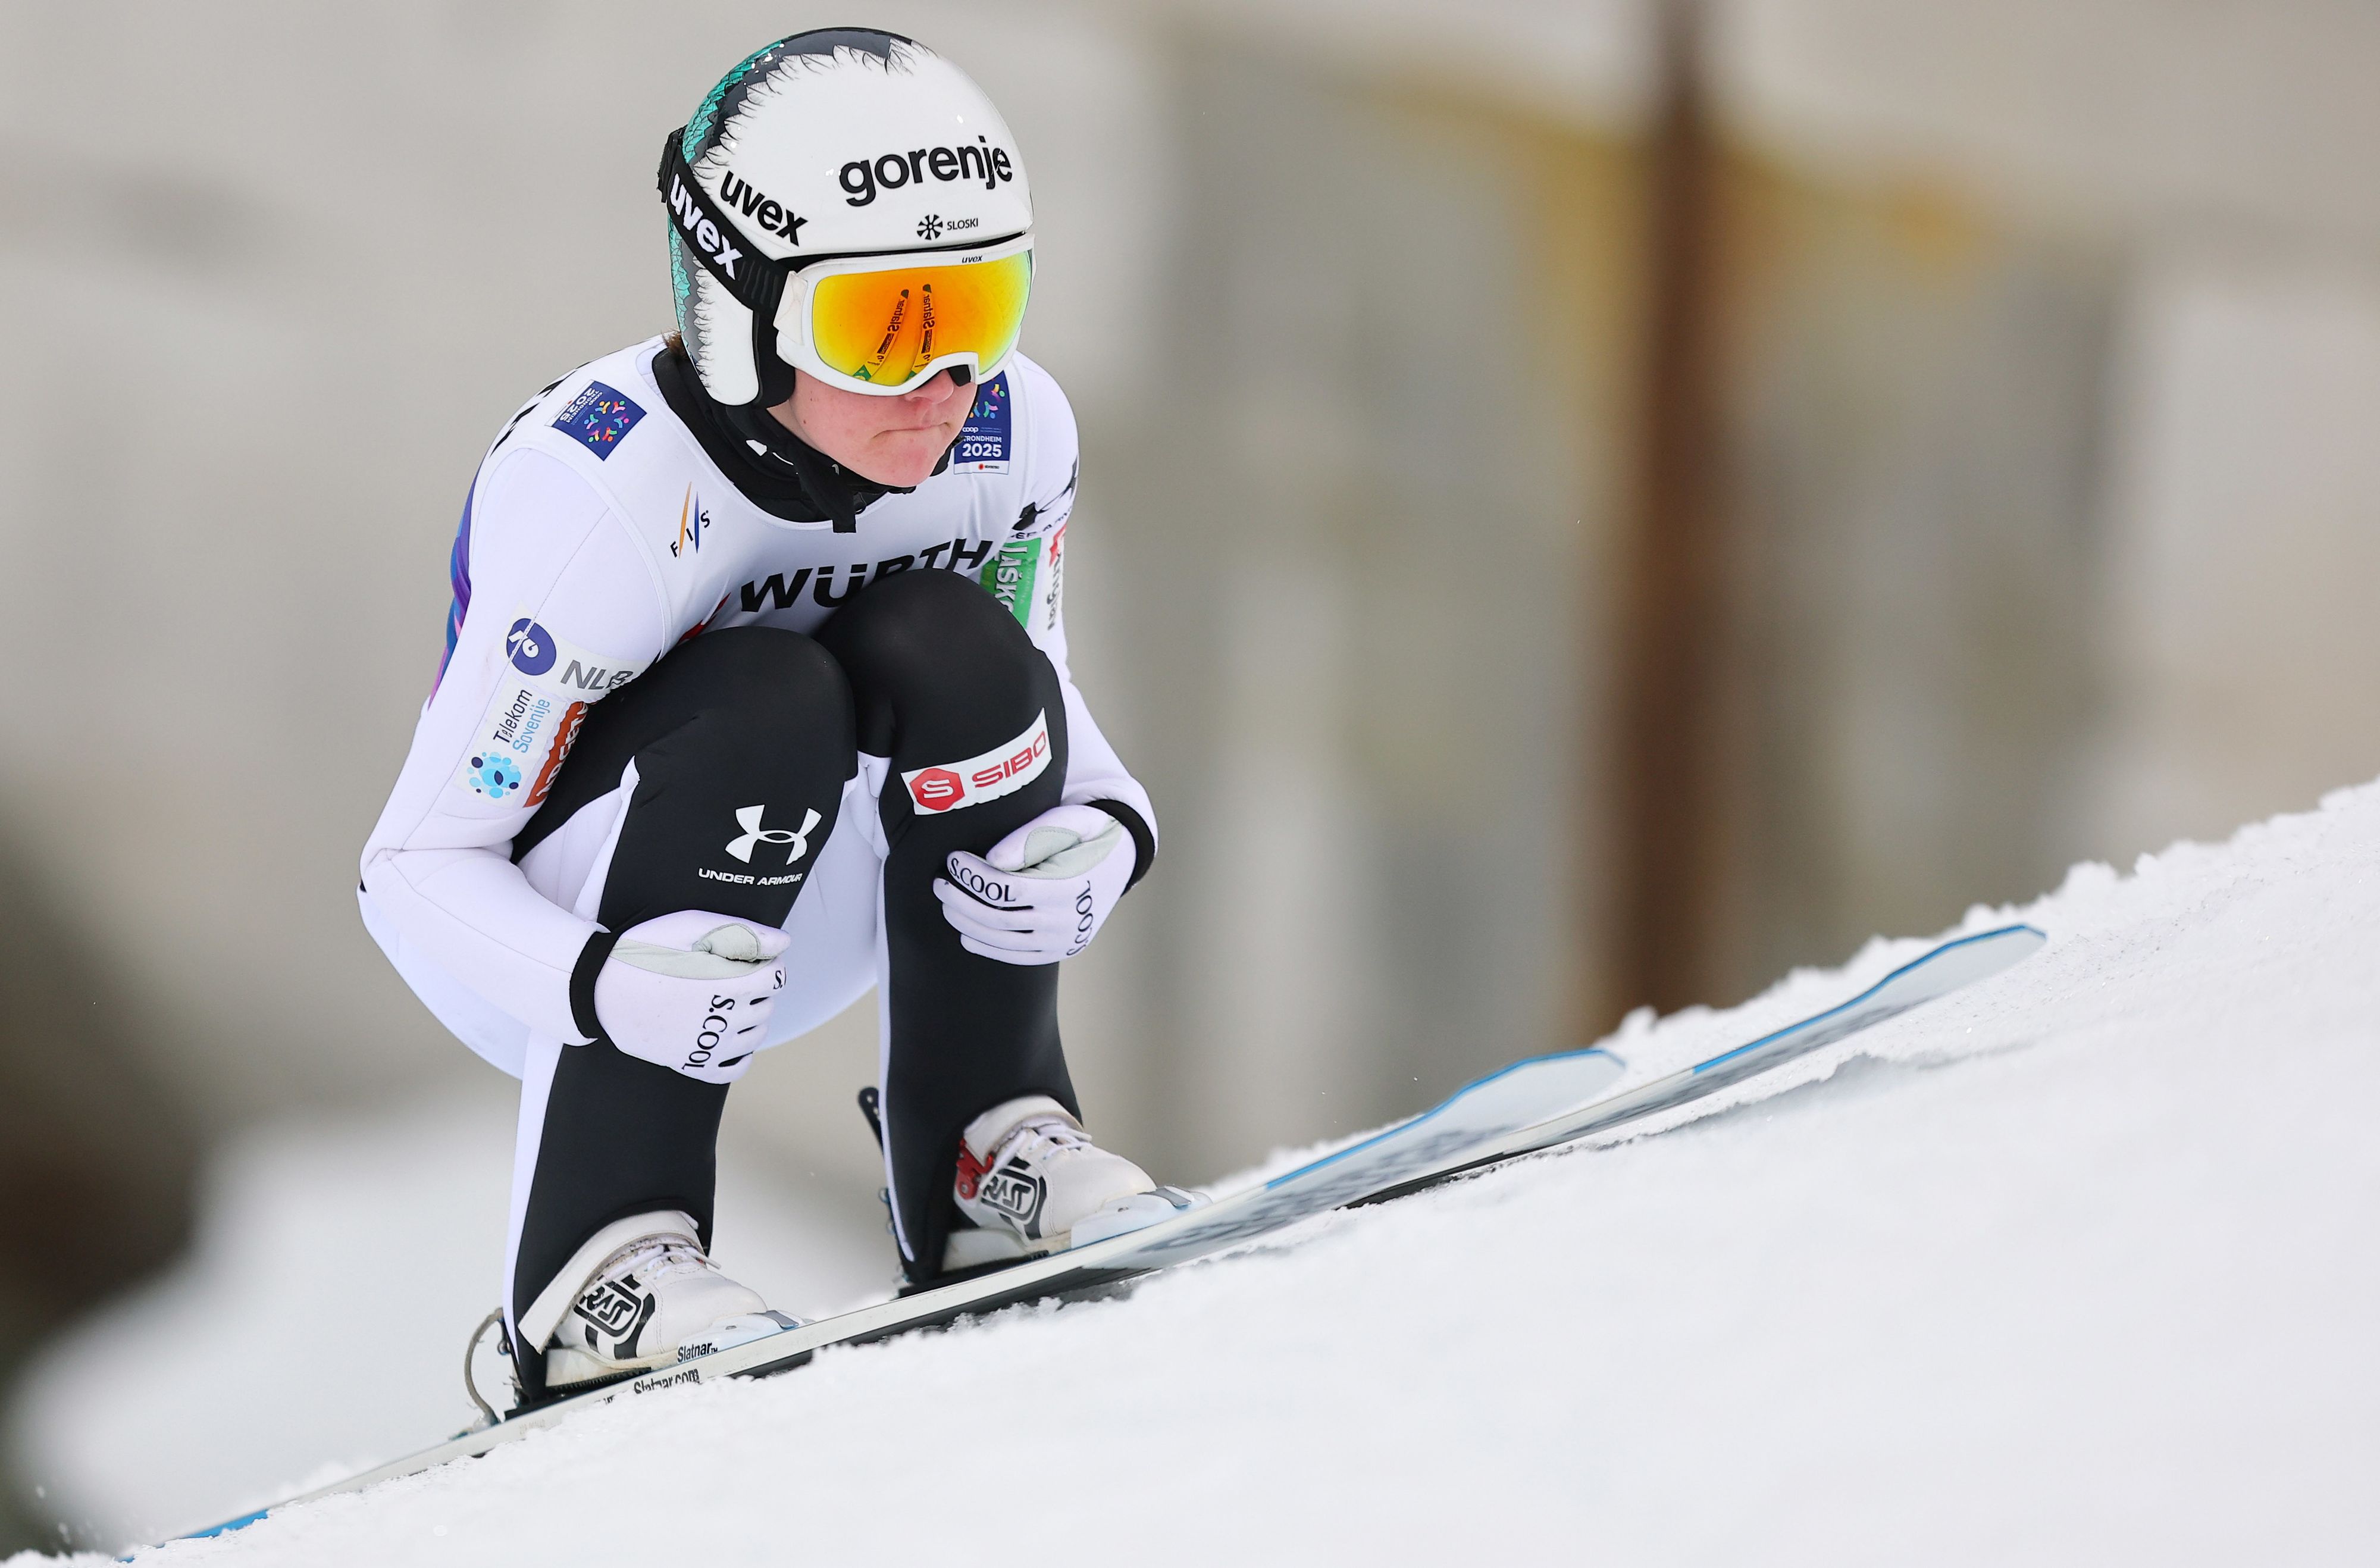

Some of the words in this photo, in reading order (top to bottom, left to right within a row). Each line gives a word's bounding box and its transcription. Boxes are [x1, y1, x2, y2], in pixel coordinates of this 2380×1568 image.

[838, 135, 1013, 206] gorenje
[669, 173, 743, 280] uvex
[719, 171, 808, 246] uvex
[947, 218, 978, 231] SLOSKI
[962, 255, 982, 263] uvex
[559, 387, 595, 421] 2025
[962, 443, 1002, 458] 2025
[493, 689, 533, 744] Telekom
[512, 699, 550, 753] Sovenije
[972, 731, 1046, 788] SIBO
[698, 868, 754, 884] UNDER
[757, 873, 803, 885] ARMOUR
[949, 858, 1016, 902] S.COOL
[677, 1342, 712, 1363] Slatnar
[634, 1369, 700, 1394] Slatnarcom
